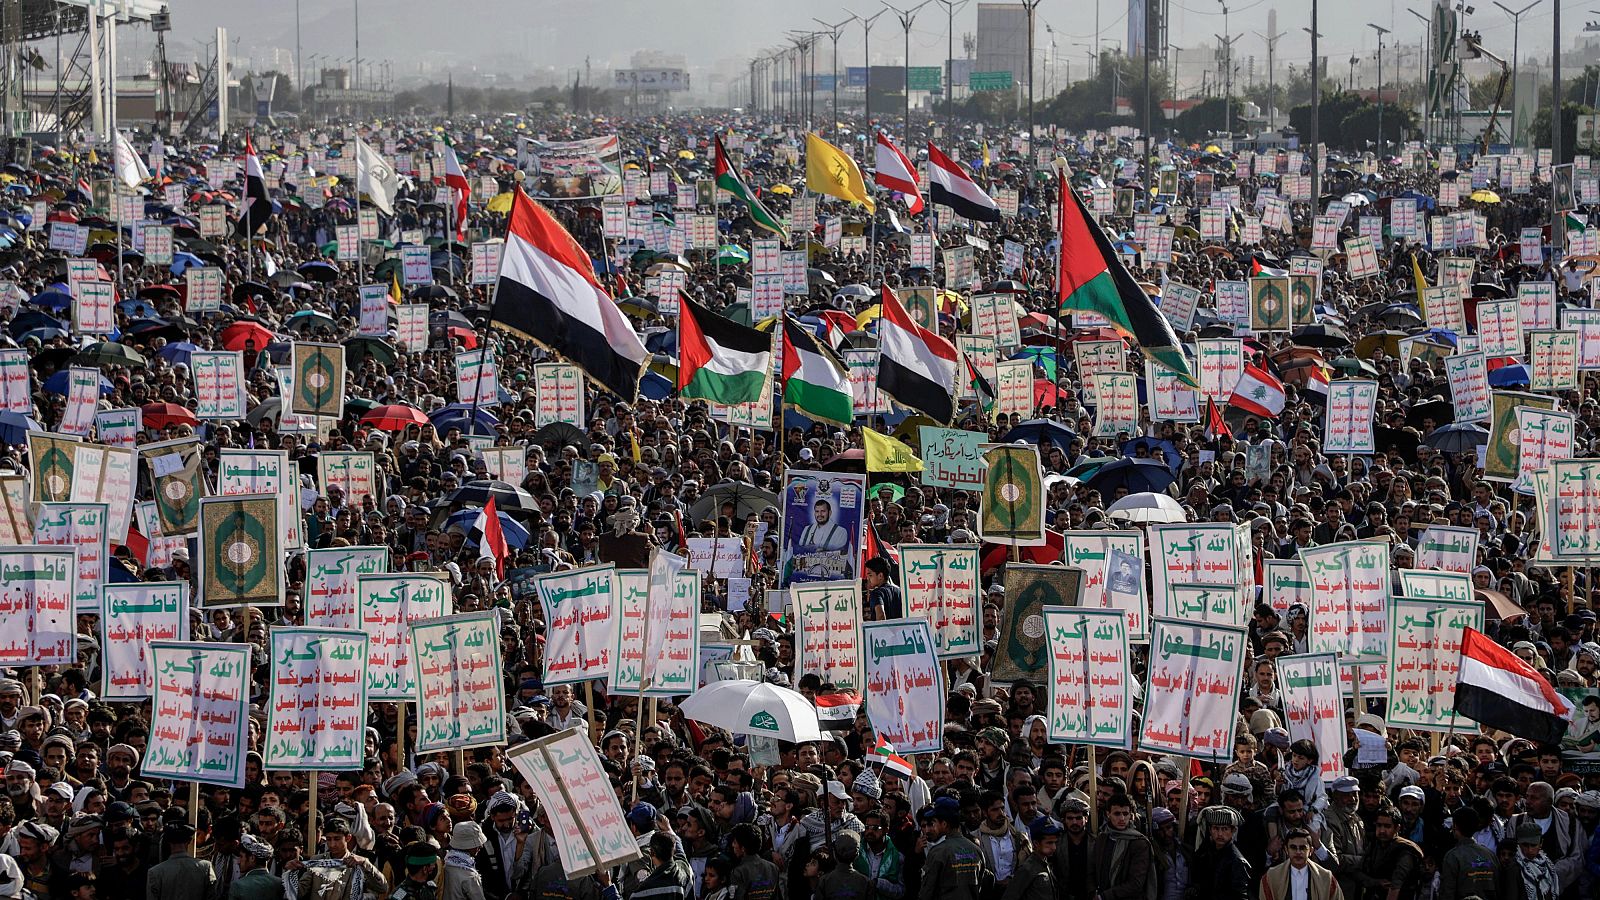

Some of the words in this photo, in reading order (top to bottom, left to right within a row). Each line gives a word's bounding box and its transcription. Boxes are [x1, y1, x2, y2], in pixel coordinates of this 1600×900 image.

[1560, 336, 1574, 344] الله
[1081, 344, 1103, 359] أكبر
[1105, 345, 1119, 355] الله
[1202, 344, 1238, 358] قاطعوا
[220, 357, 235, 367] الله
[1469, 358, 1484, 369] الله
[563, 368, 576, 378] الله
[1120, 378, 1132, 387] الله
[1358, 385, 1372, 398] الله
[1523, 417, 1551, 433] أكبر
[1552, 421, 1569, 434] الله
[1549, 439, 1569, 448] الموت
[223, 461, 277, 480] قاطعوا
[328, 457, 352, 474] أكبر
[354, 458, 370, 470] الله
[938, 463, 986, 487] الخطوط
[38, 506, 76, 532] أكبر
[78, 510, 103, 525] الله
[1560, 520, 1582, 532] اليهود
[1585, 521, 1596, 532] على
[73, 532, 102, 545] الموت
[1166, 532, 1204, 558] أكبر
[1207, 534, 1231, 551] الله
[1560, 535, 1590, 552] للإسلام
[312, 553, 355, 581] أكبر
[356, 555, 382, 573] الله
[907, 551, 946, 576] أكبر
[949, 553, 974, 570] الله
[1167, 558, 1202, 574] لأمريكا
[1204, 560, 1232, 573] الموت
[1312, 547, 1351, 576] أكبر
[1355, 547, 1383, 569] الله
[311, 580, 347, 597] لأمريكا
[545, 575, 610, 608] قاطعوا
[909, 575, 943, 592] لأمريكا
[945, 579, 974, 591] الموت
[1353, 577, 1384, 593] الموت
[36, 588, 70, 614] البضائع
[363, 581, 410, 608] أكبر
[411, 584, 440, 602] الله
[1101, 592, 1107, 607] و
[108, 593, 177, 618] قاطعوا
[310, 603, 346, 619] لإسرائيل
[803, 593, 832, 616] أكبر
[834, 594, 854, 611] الله
[910, 596, 943, 612] لإسرائيل
[945, 596, 975, 609] الموت
[1179, 592, 1210, 617] أكبر
[1212, 595, 1233, 614] الله
[1354, 599, 1385, 615] الموت
[27, 615, 33, 633] و
[364, 609, 403, 625] لأمريكا
[581, 604, 611, 626] البضائع
[935, 616, 949, 630] على
[952, 614, 975, 626] اللعنة
[1399, 605, 1447, 633] أكبر
[1448, 610, 1478, 629] الله
[108, 622, 143, 643] الأمريكية
[831, 619, 855, 632] الموت
[1052, 616, 1091, 644] أكبر
[1093, 619, 1121, 640] الله
[1313, 619, 1341, 636] اليهود
[1344, 620, 1359, 636] على
[1361, 619, 1386, 633] اللعنة
[419, 626, 460, 658] أكبر
[464, 626, 491, 647] الله
[574, 630, 580, 645] و
[832, 637, 856, 651] الموت
[945, 630, 975, 652] النصر
[1159, 626, 1234, 662] قاطعوا
[1398, 633, 1439, 652] لأمريكا
[140, 647, 145, 662] و
[278, 635, 329, 668] أكبر
[330, 639, 362, 660] الله
[668, 647, 692, 660] اللعنة
[870, 629, 927, 665] قاطعوا
[1054, 646, 1088, 663] لأمريكا
[160, 651, 208, 677] أكبر
[392, 653, 408, 668] على
[421, 655, 458, 677] لأمريكا
[461, 654, 493, 674] الموت
[823, 657, 836, 671] على
[1090, 649, 1122, 665] الموت
[1397, 656, 1438, 675] لإسرائيل
[209, 656, 241, 678] الله
[659, 665, 691, 687] النصر
[277, 666, 320, 688] لأمريكا
[324, 669, 361, 686] الموت
[463, 675, 496, 694] الموت
[868, 665, 900, 696] الأمريكية
[904, 666, 936, 694] البضائع
[1091, 671, 1123, 688] الموت
[1151, 665, 1194, 693] الأمريكية
[1195, 671, 1235, 700] البضائع
[1283, 661, 1332, 695] قاطعوا
[1395, 678, 1424, 694] اليهود
[160, 678, 200, 697] لأمريكا
[203, 687, 239, 702] الموت
[1427, 680, 1444, 695] على
[322, 693, 359, 710] الموت
[453, 700, 468, 718] على
[472, 697, 497, 712] اللعنة
[898, 696, 904, 716] و
[1055, 692, 1080, 709] اليهود
[1082, 694, 1096, 710] على
[1099, 693, 1122, 709] اللعنة
[1184, 697, 1191, 717] و
[1393, 697, 1434, 720] للإسلام
[201, 710, 236, 724] الموت
[424, 701, 450, 720] اليهود
[1313, 699, 1337, 725] البضائع
[273, 717, 305, 735] اليهود
[309, 716, 325, 735] على
[330, 716, 359, 731] اللعنة
[464, 715, 498, 740] النصر
[1054, 711, 1088, 738] للإسلام
[1090, 713, 1122, 737] النصر
[155, 726, 184, 743] اليهود
[187, 731, 204, 747] على
[207, 729, 235, 747] اللعنة
[423, 720, 460, 746] للإسلام
[270, 738, 316, 764] للإسلام
[318, 735, 358, 763] النصر
[149, 745, 192, 773] للإسلام
[194, 751, 233, 774] النصر
